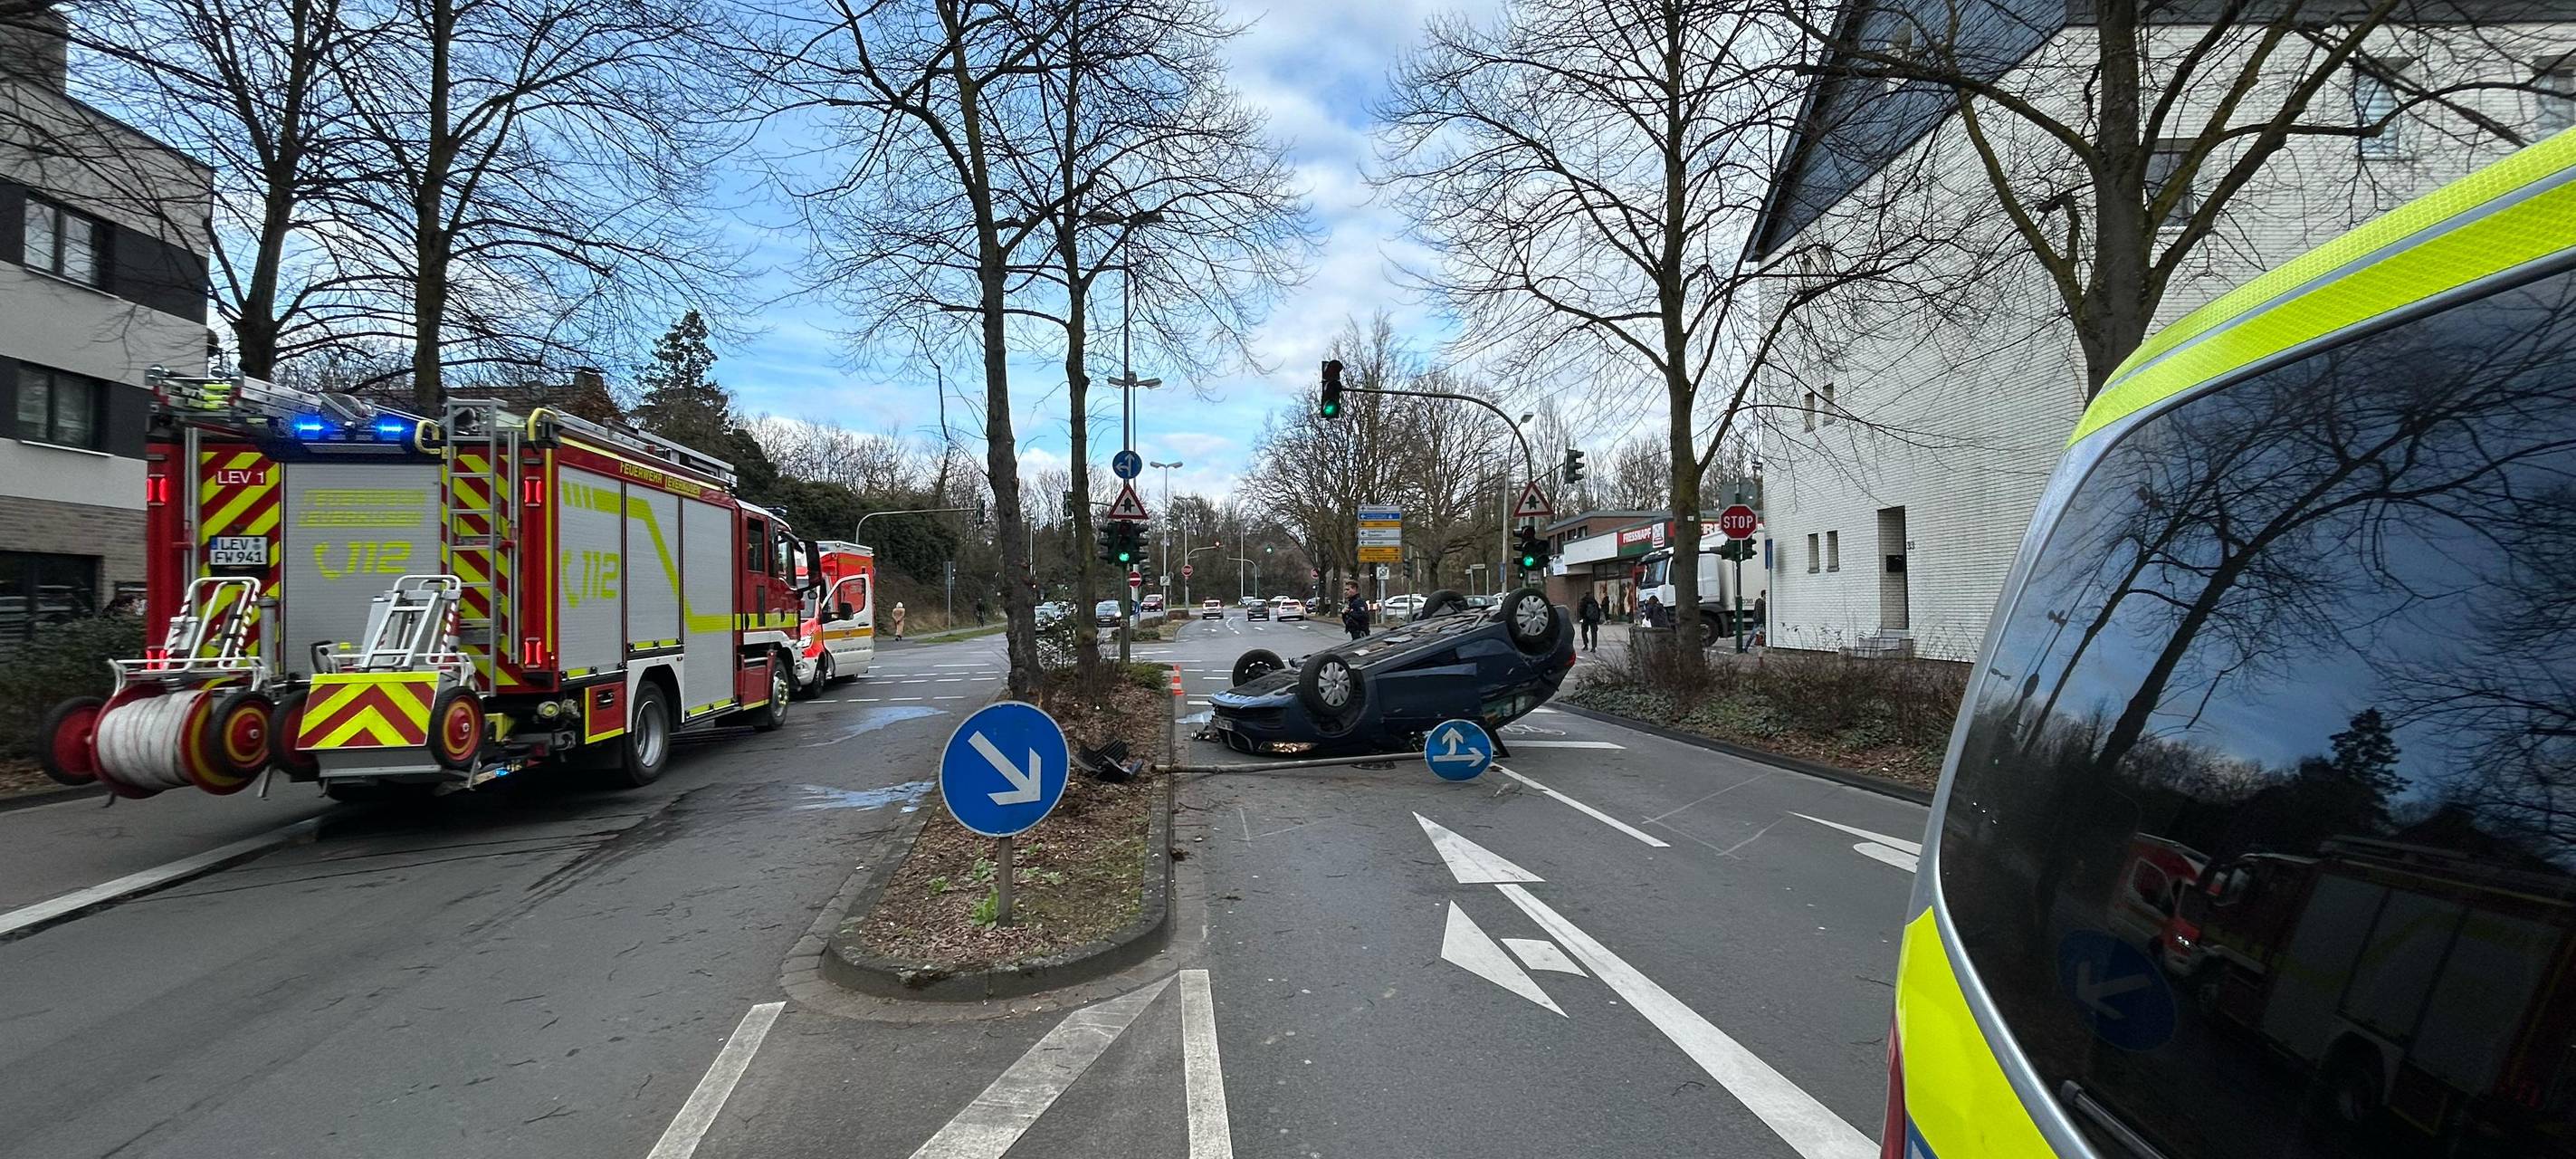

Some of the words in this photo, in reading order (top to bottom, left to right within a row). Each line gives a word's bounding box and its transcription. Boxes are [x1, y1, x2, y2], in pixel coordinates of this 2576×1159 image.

[217, 470, 252, 484] LEV
[256, 470, 265, 484] 1
[619, 460, 663, 484] FEUERWEHR
[1723, 515, 1754, 530] STOP
[220, 538, 249, 551] LEV
[214, 551, 234, 563] FW
[236, 551, 263, 563] 941
[346, 541, 414, 575] 112
[581, 550, 620, 601] 112
